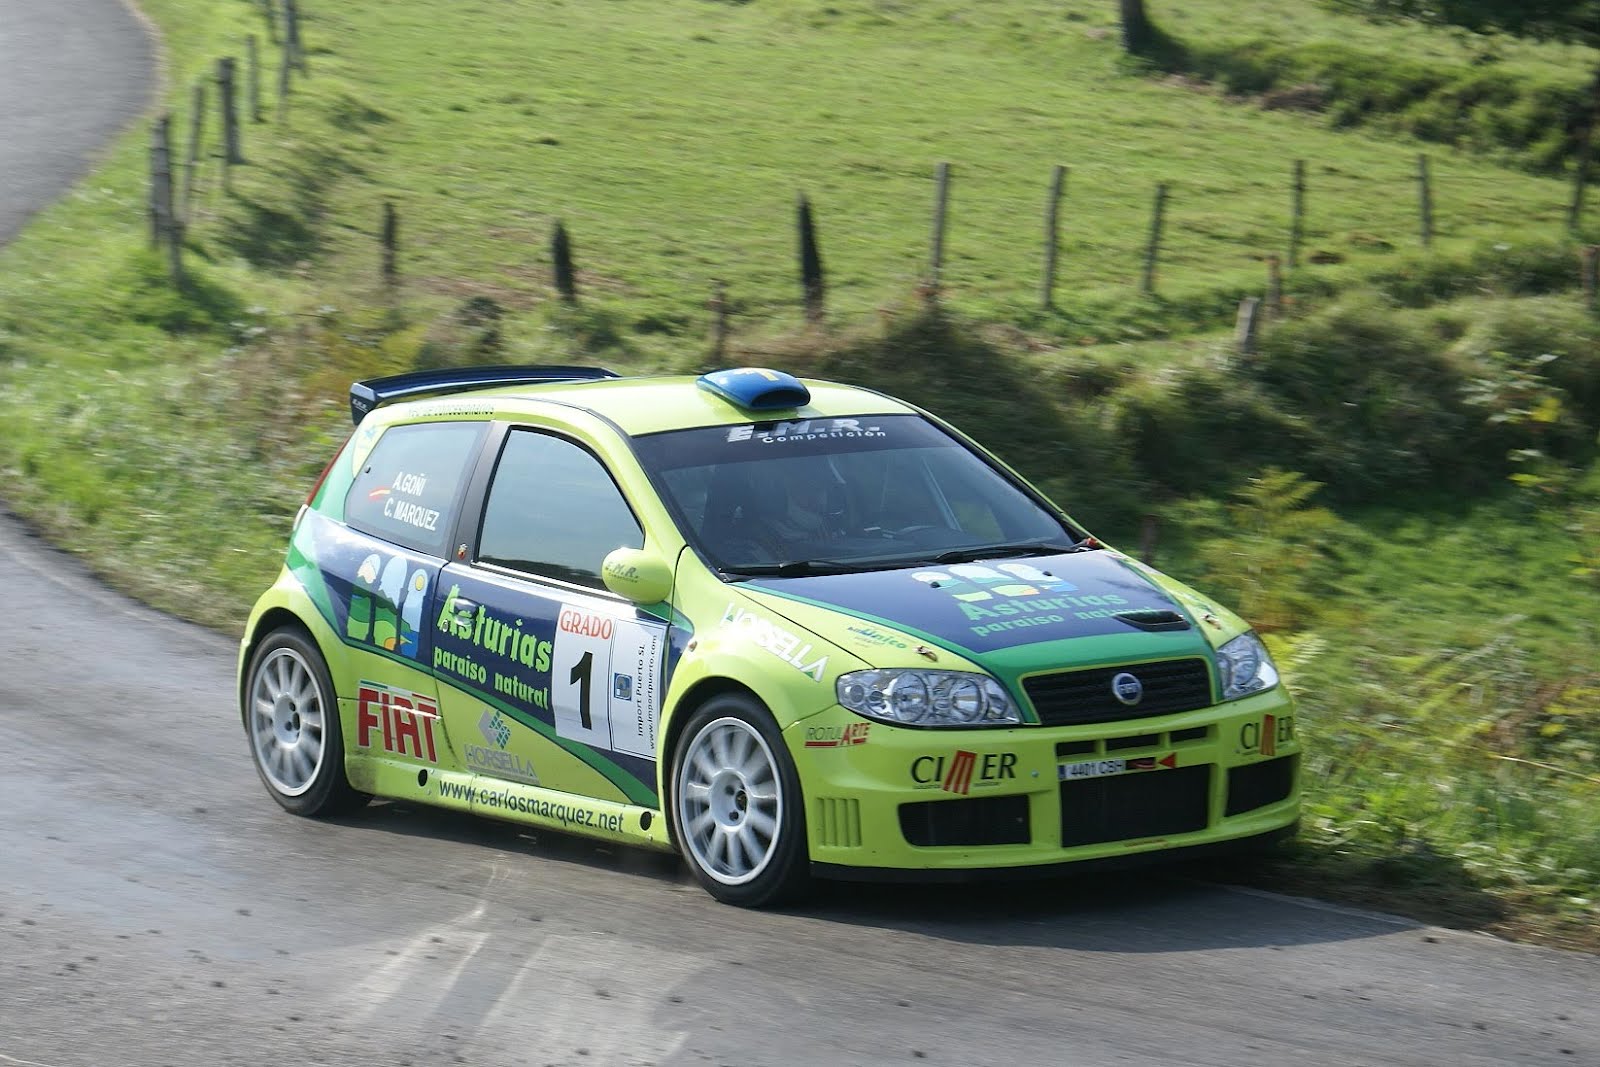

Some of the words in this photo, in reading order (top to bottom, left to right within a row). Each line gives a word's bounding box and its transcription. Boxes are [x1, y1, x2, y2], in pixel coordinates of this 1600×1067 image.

[762, 430, 887, 443] Competición
[384, 497, 394, 517] C.
[393, 500, 440, 531] MARQUEZ
[560, 610, 612, 639] GRADO
[957, 593, 1129, 621] Asturias
[970, 614, 1066, 637] paraiso
[437, 584, 552, 672] Asturias
[638, 644, 645, 656] SL
[433, 646, 487, 684] paraiso
[494, 672, 548, 710] natural
[570, 651, 593, 730] 1
[636, 659, 644, 696] Puerto
[646, 634, 658, 750] www.importpuerto.com
[358, 687, 438, 763] FIAT
[636, 700, 644, 737] Import
[464, 743, 541, 782] HORSELLA
[911, 750, 1018, 796] CIMER
[439, 779, 624, 833] www.carlosmarquez.net
